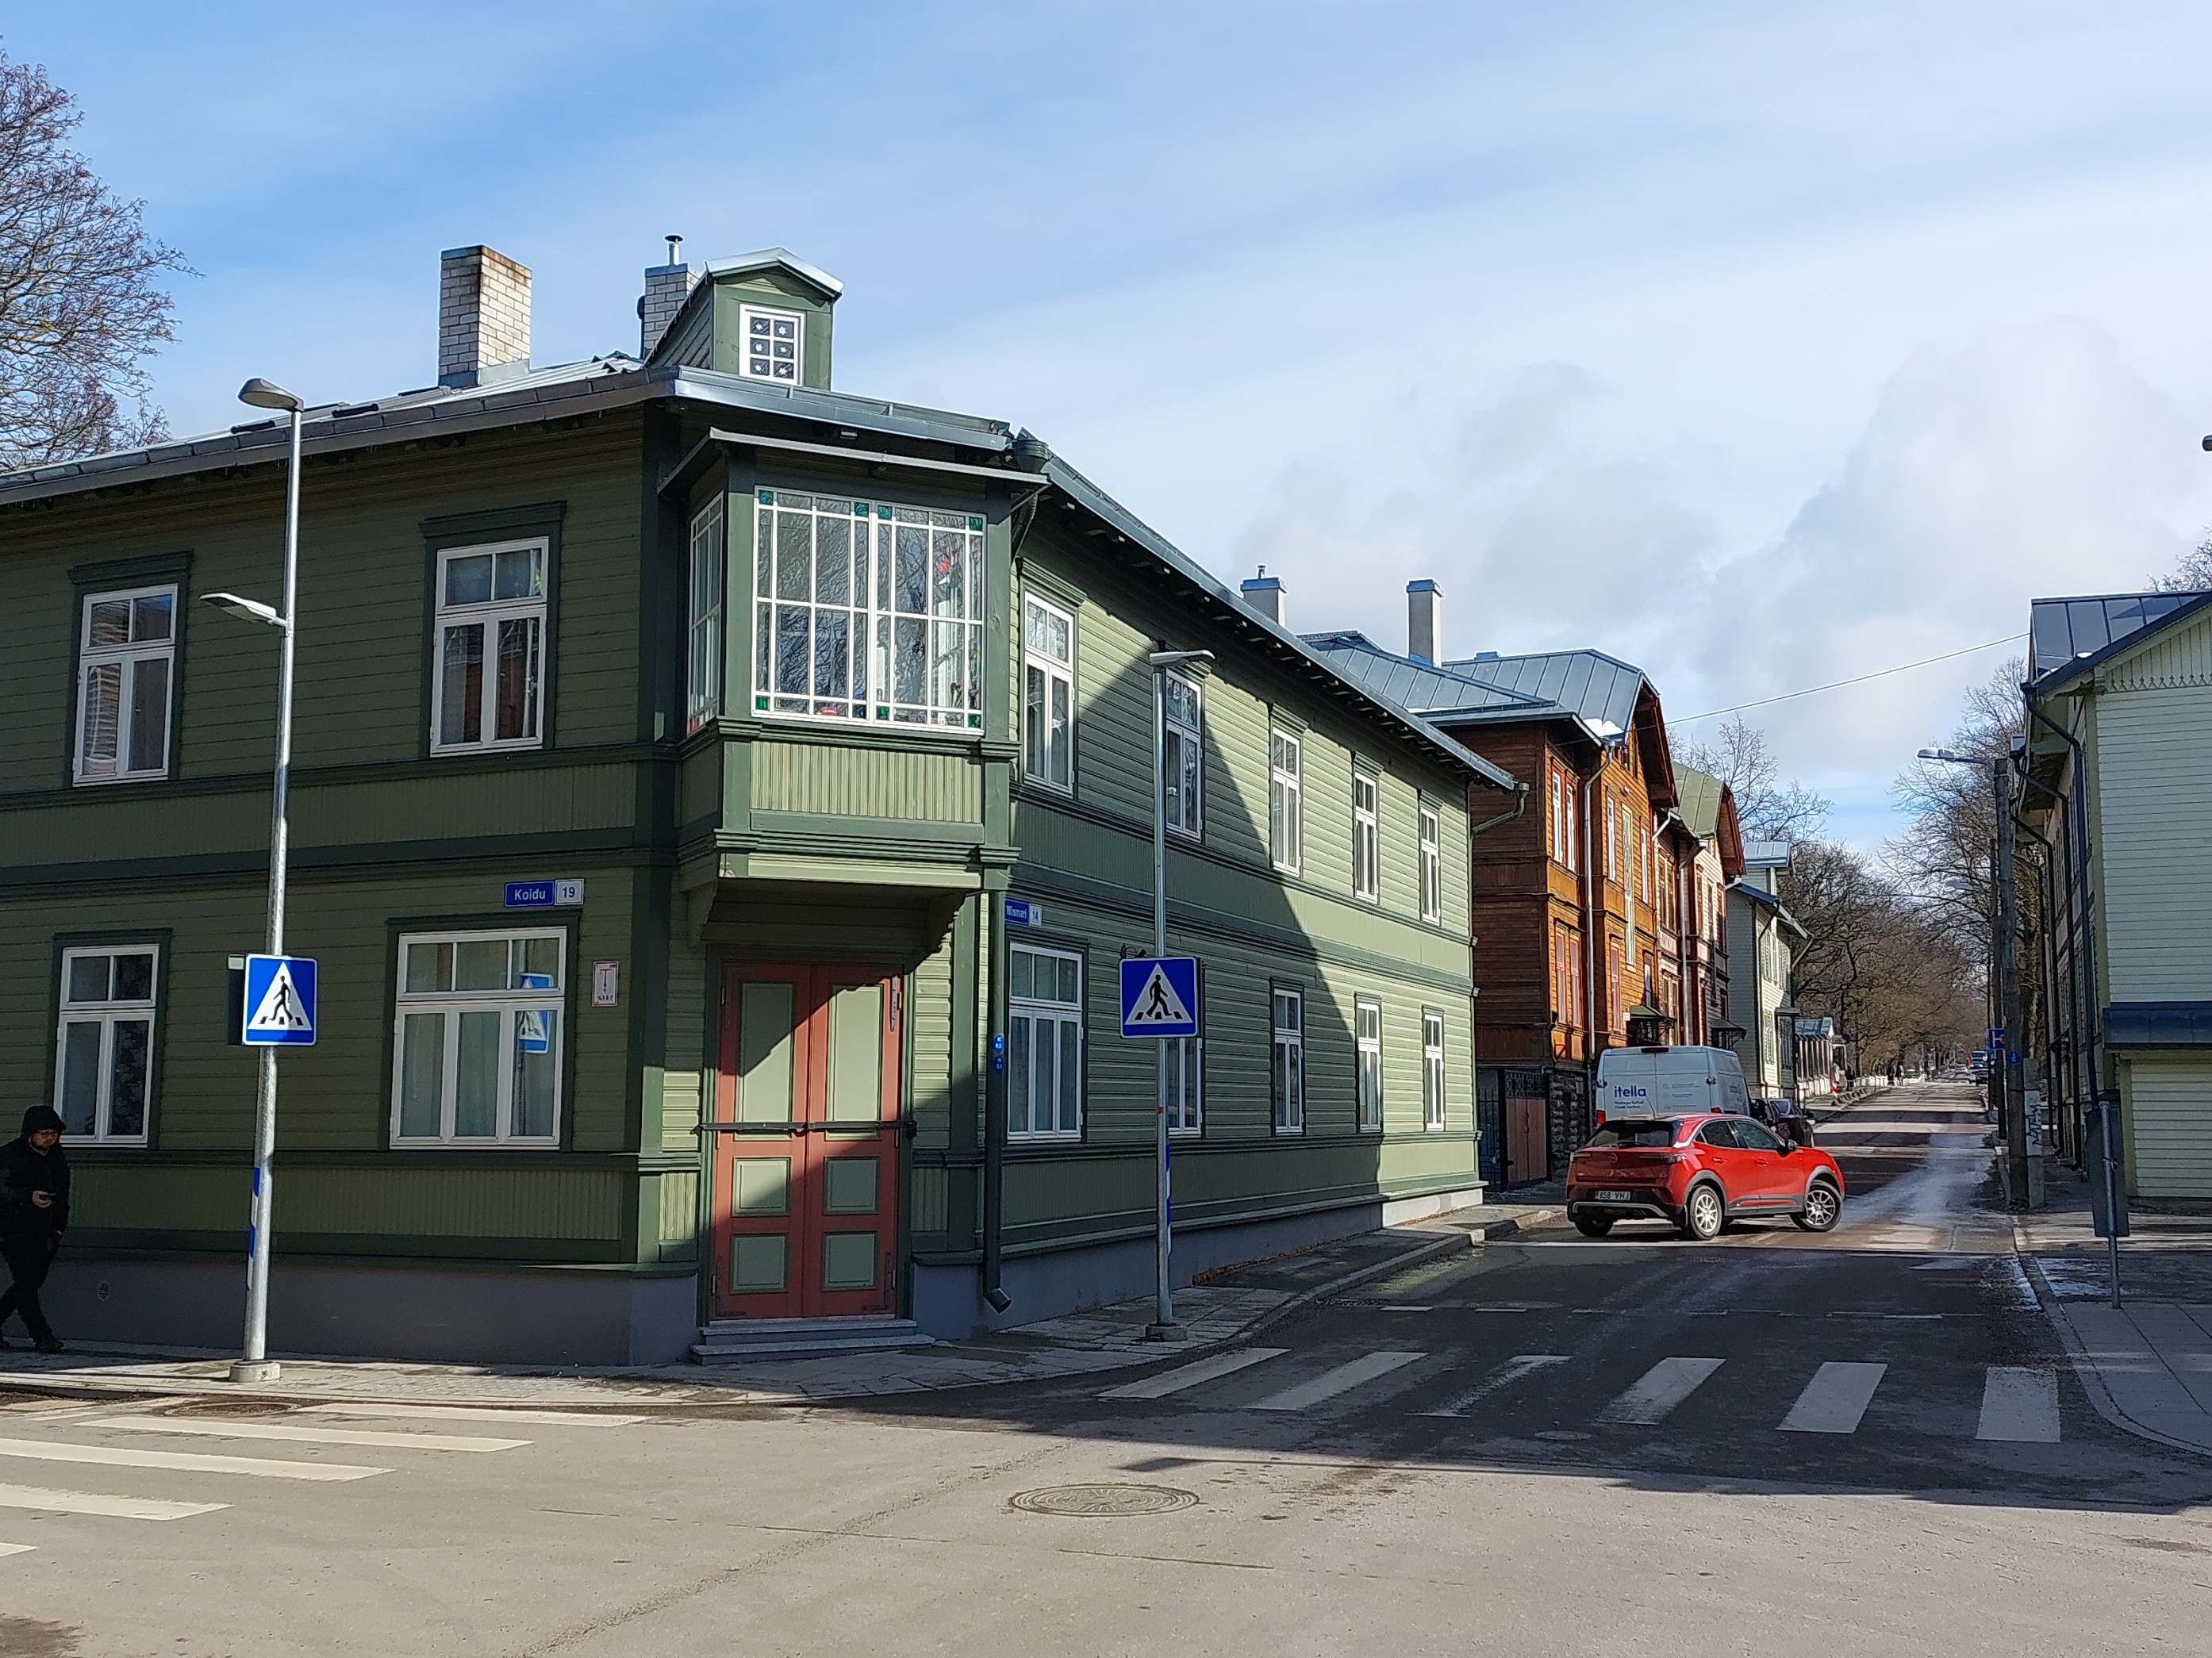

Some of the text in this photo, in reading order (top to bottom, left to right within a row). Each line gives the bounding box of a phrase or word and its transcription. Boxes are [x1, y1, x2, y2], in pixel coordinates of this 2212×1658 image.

[514, 886, 575, 901] Koidu 19
[1032, 910, 1039, 921] 14
[1614, 1084, 1647, 1098] itella
